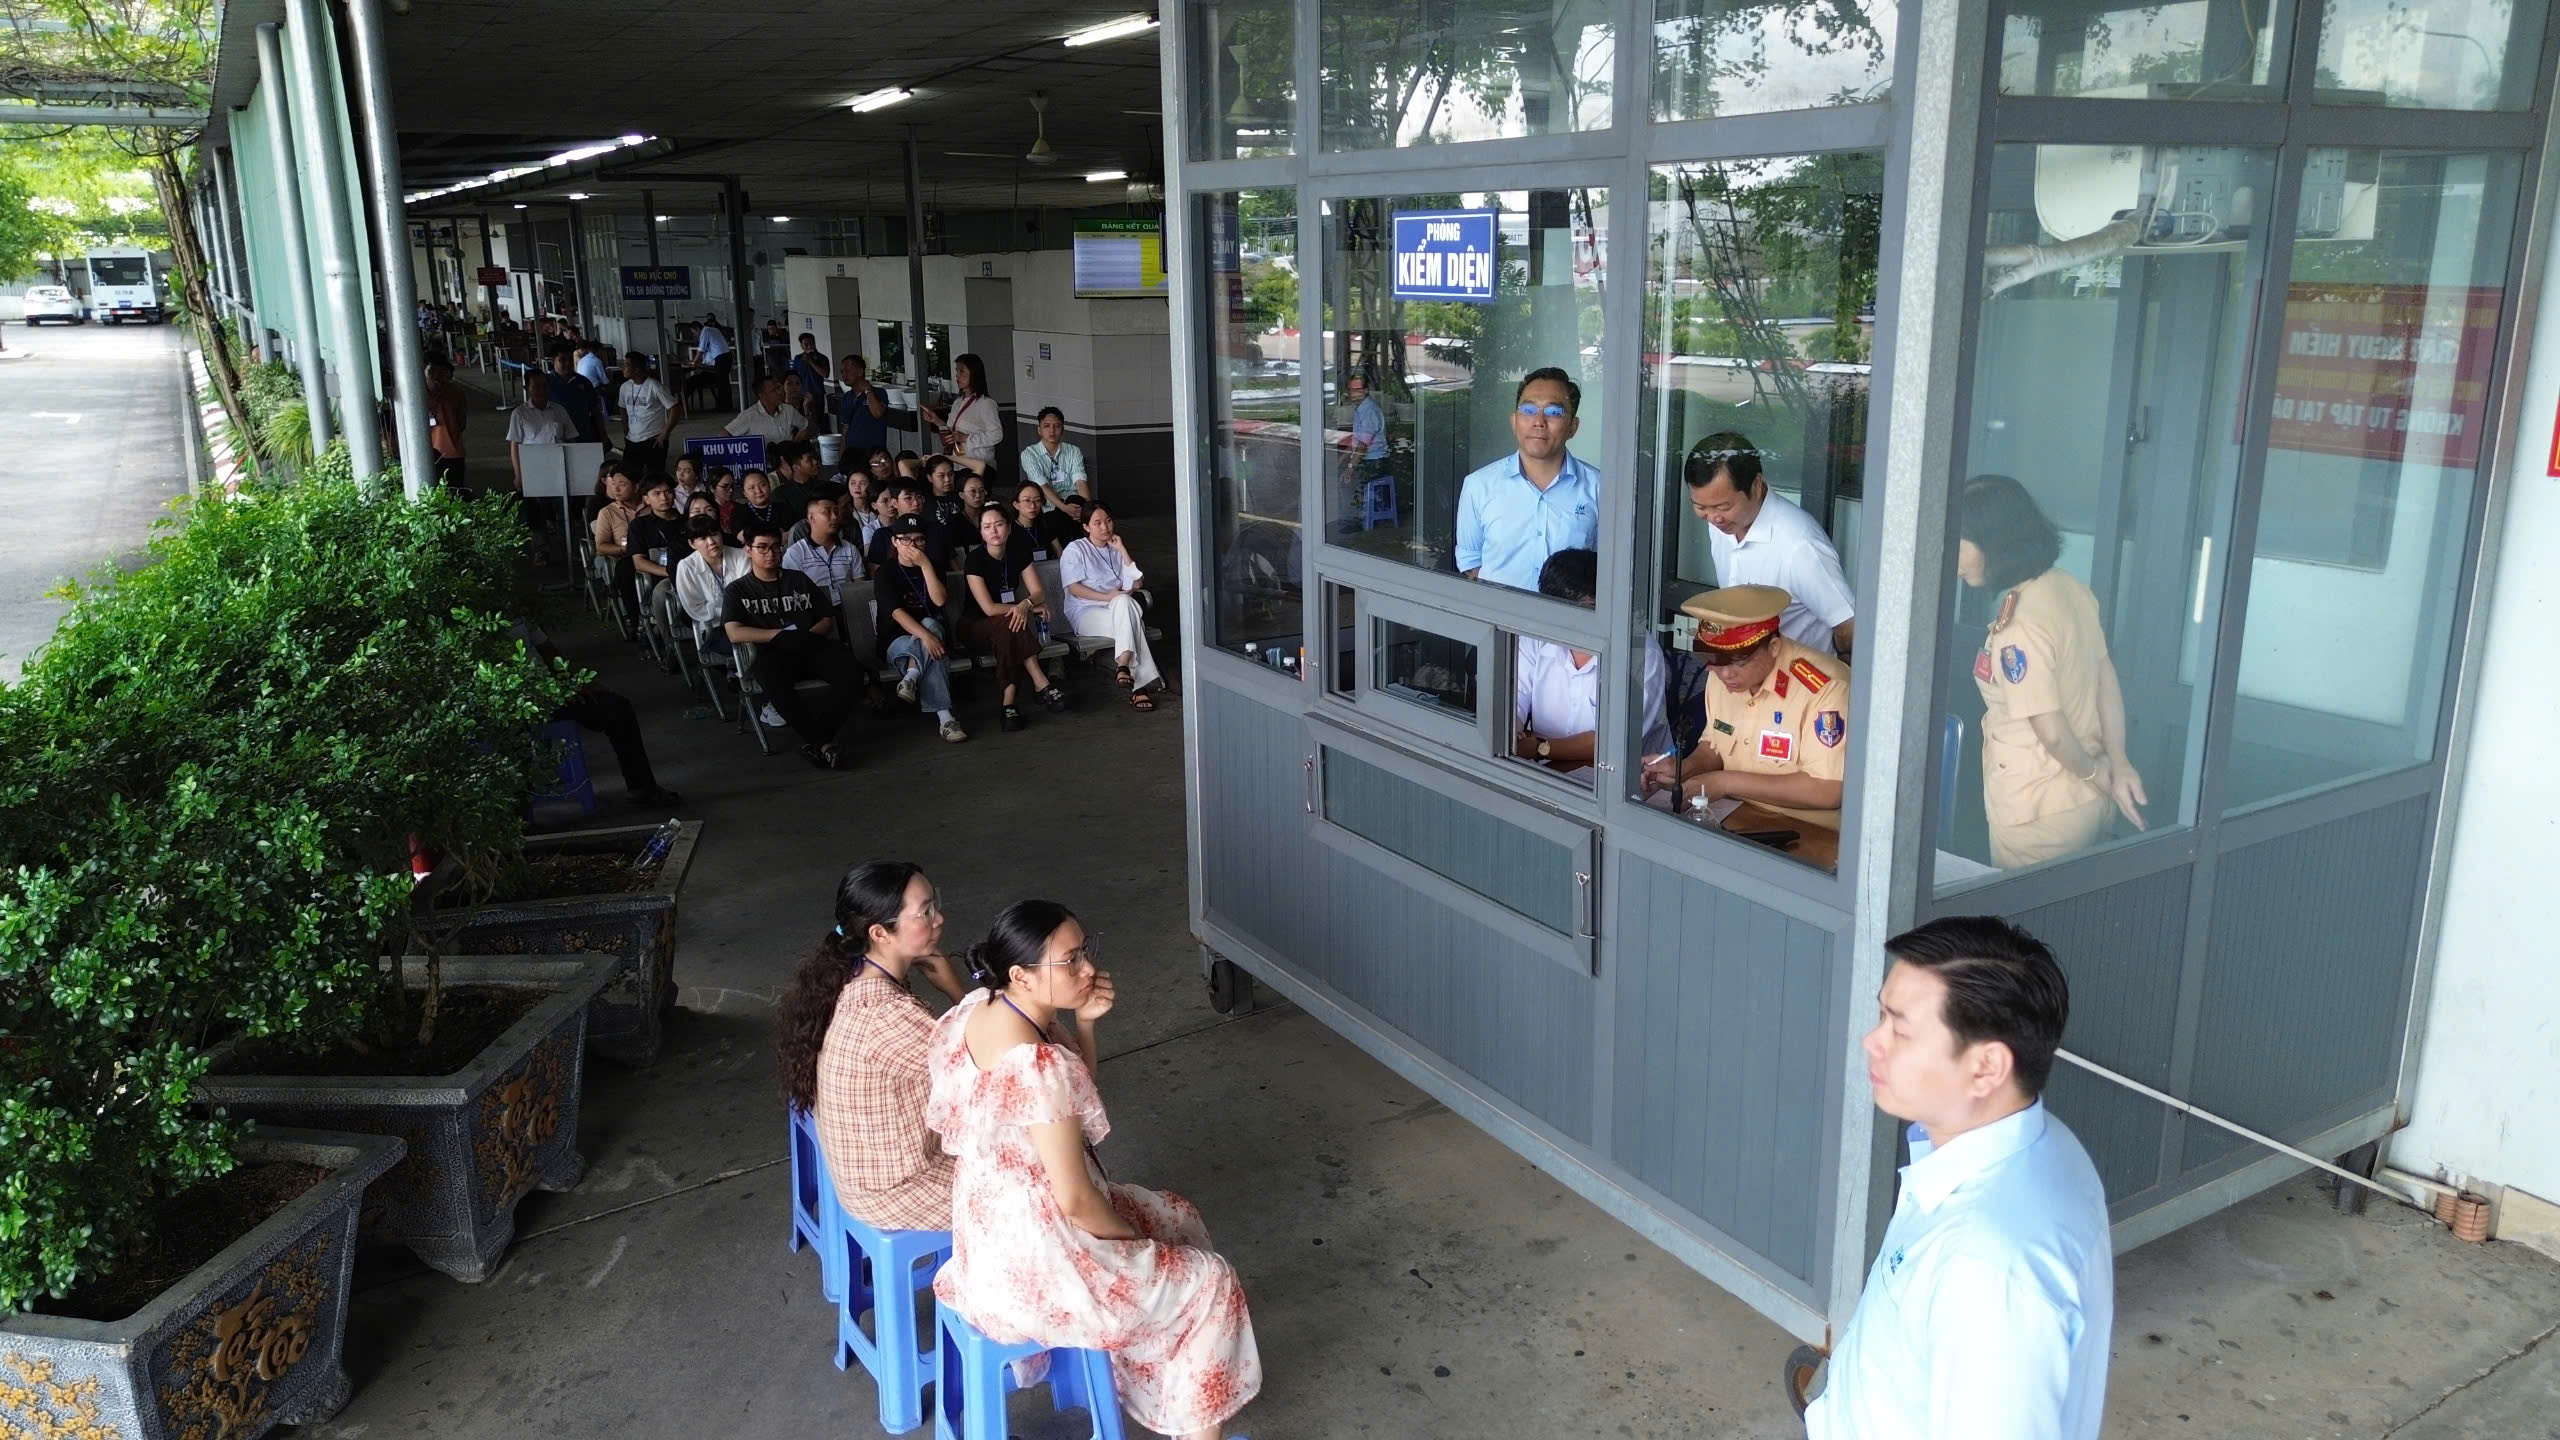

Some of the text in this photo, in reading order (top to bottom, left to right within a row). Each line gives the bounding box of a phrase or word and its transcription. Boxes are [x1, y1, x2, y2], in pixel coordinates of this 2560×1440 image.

[1101, 222, 1124, 230] BẢNG
[1125, 221, 1141, 230] KẾT
[1426, 218, 1460, 241] PHÒNG
[1398, 239, 1489, 294] KIỂM DIỆN
[633, 271, 648, 280] KHU
[648, 269, 662, 282] VỰC
[703, 441, 749, 457] KHU VỰC
